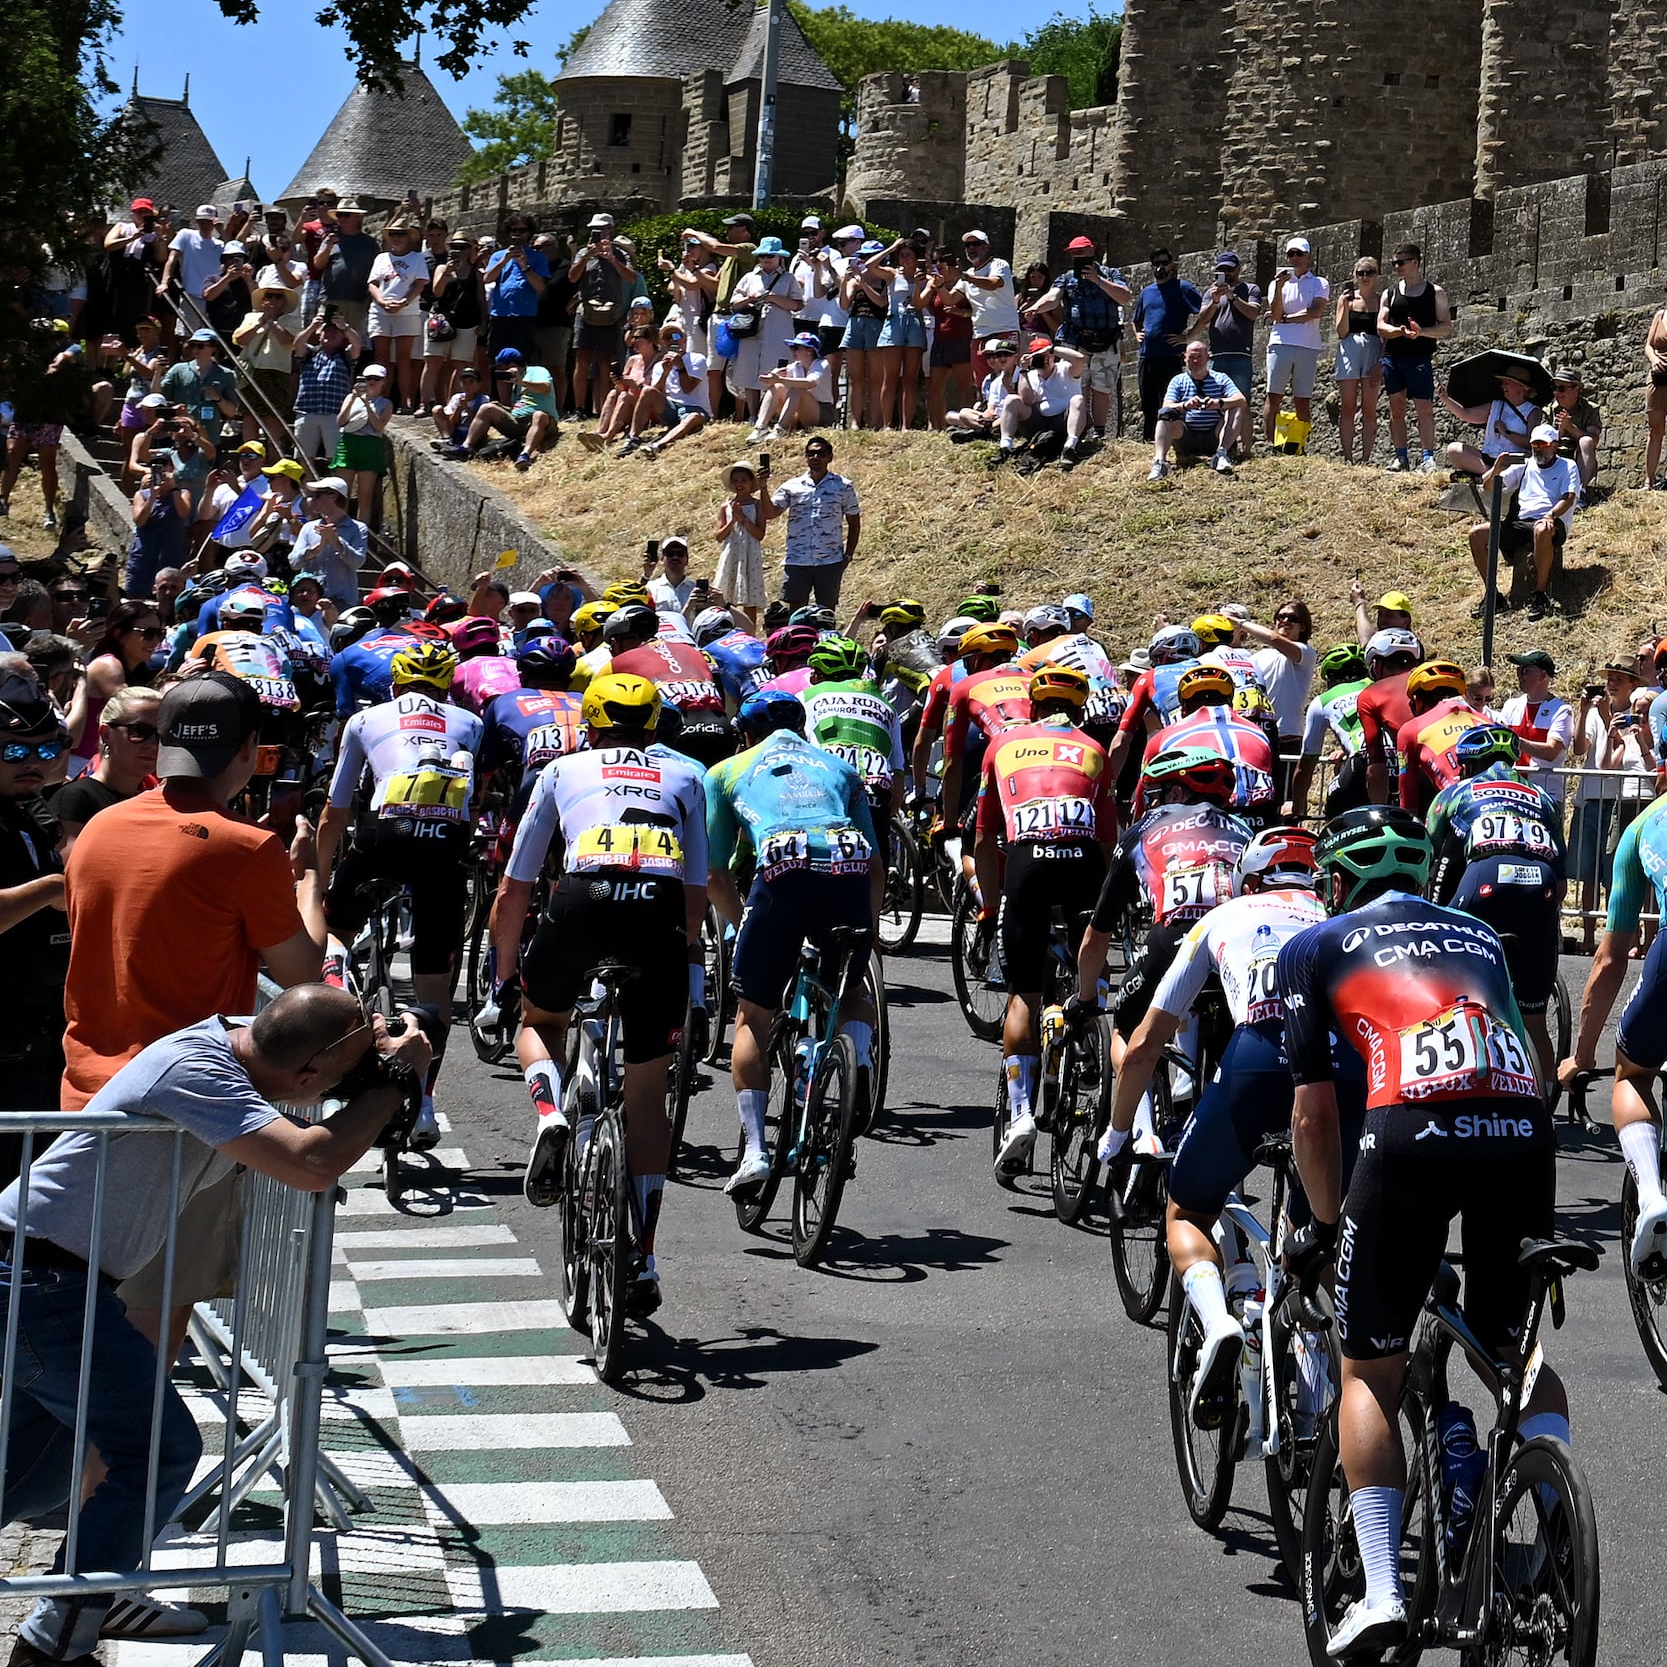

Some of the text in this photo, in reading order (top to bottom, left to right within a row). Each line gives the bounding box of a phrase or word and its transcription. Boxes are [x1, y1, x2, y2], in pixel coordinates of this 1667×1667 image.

[994, 684, 1023, 694] Uno
[398, 697, 447, 718] UAE
[813, 696, 849, 712] CAJA
[404, 716, 443, 730] Emirates
[530, 731, 563, 751] 213
[1015, 746, 1050, 760] Uno
[601, 748, 661, 770] UAE
[606, 767, 656, 782] Emirates
[403, 775, 418, 802] 7
[604, 785, 662, 801] XRG
[1472, 788, 1542, 807] SOUDAL
[414, 821, 448, 839] IHC
[1016, 804, 1054, 835] 121
[1481, 816, 1507, 840] 97
[596, 828, 673, 857] 4 4
[1323, 824, 1369, 850] VAN RYSEL
[1438, 856, 1450, 884] 1000
[612, 882, 657, 902] IHC
[1172, 871, 1206, 906] 57
[1373, 921, 1502, 948] DECATHLON
[1373, 938, 1497, 968] CMA CGM
[1356, 1017, 1388, 1096] CMA CGM
[1414, 1019, 1466, 1077] 55
[1401, 1071, 1537, 1100] VELUX VELUX
[1454, 1112, 1533, 1139] Shine
[1333, 1214, 1359, 1342] CMA CGM
